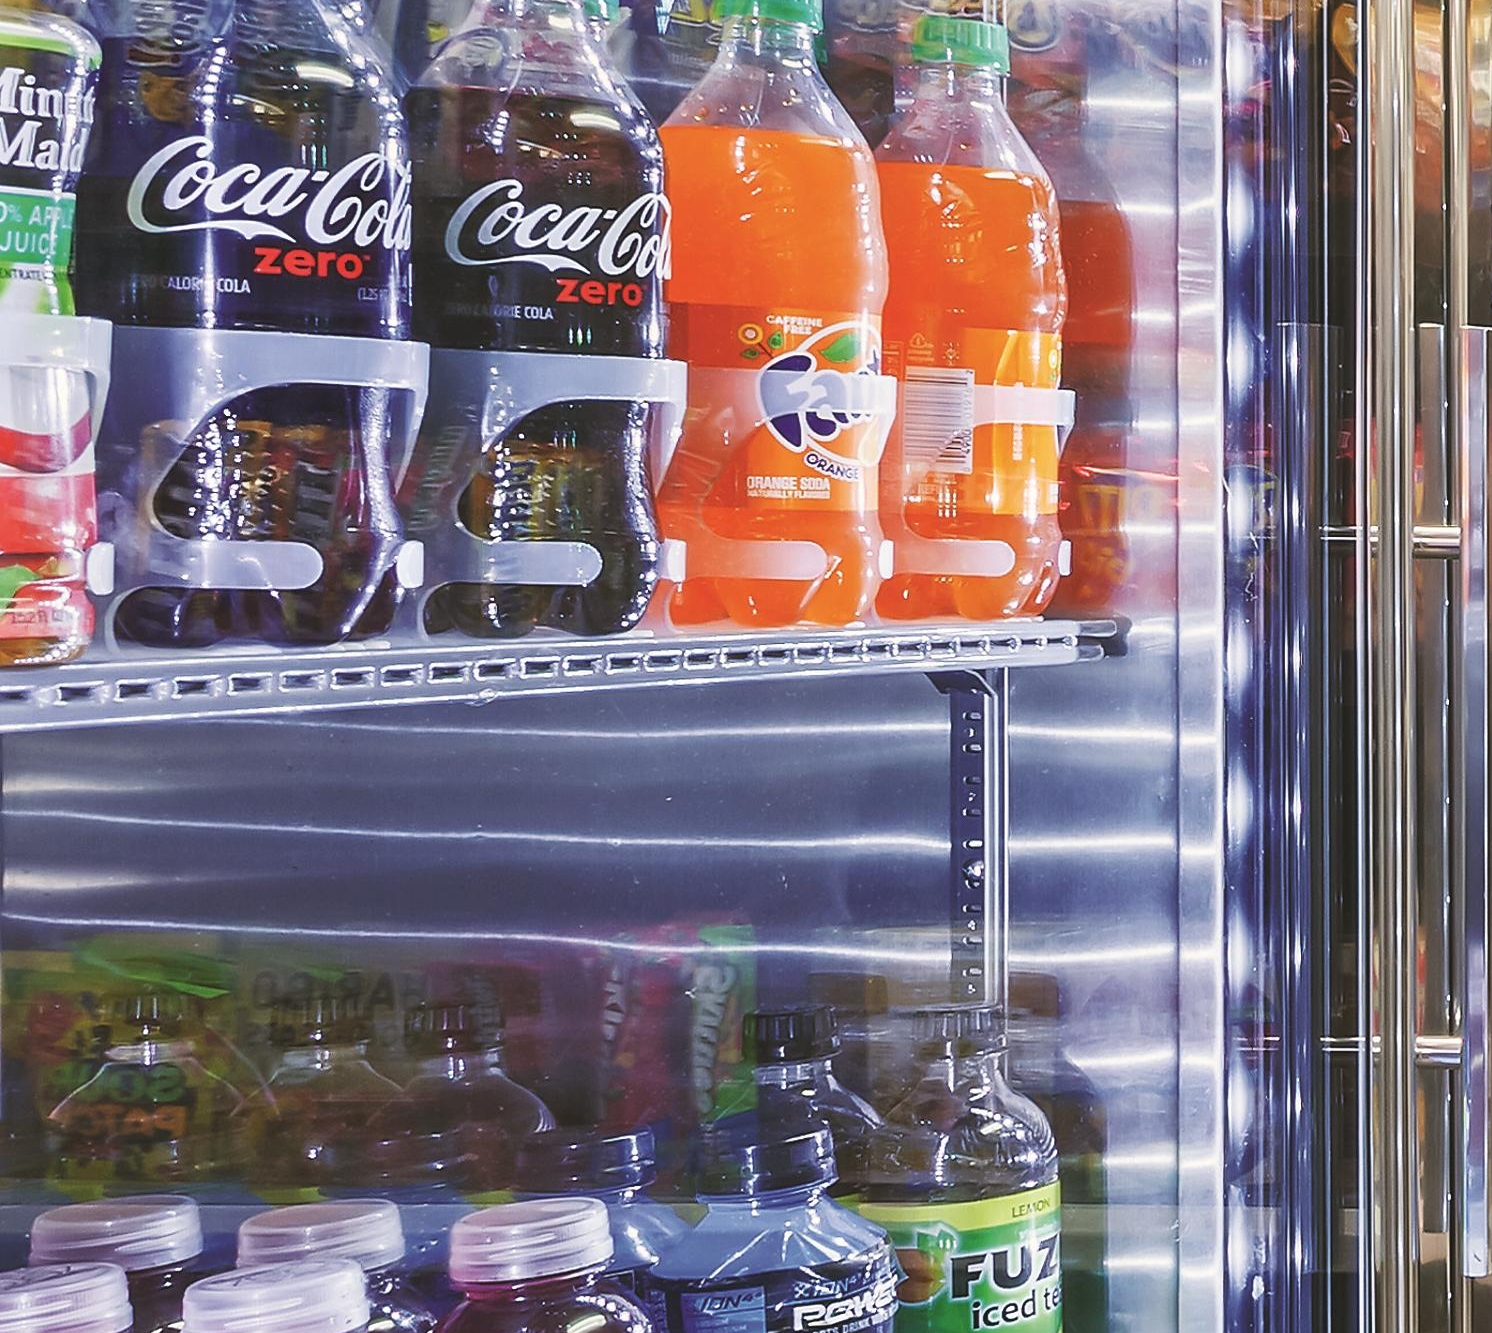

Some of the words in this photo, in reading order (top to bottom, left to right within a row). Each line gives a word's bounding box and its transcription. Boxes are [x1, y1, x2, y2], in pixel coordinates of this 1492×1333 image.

[128, 135, 411, 250] Coca-Cola
[254, 247, 363, 281] zero
[217, 279, 250, 292] COLA
[556, 279, 643, 306] zero
[524, 307, 553, 319] COLA
[806, 453, 859, 479] ORANGE
[748, 477, 796, 490] ORANGE
[800, 478, 830, 490] SODA
